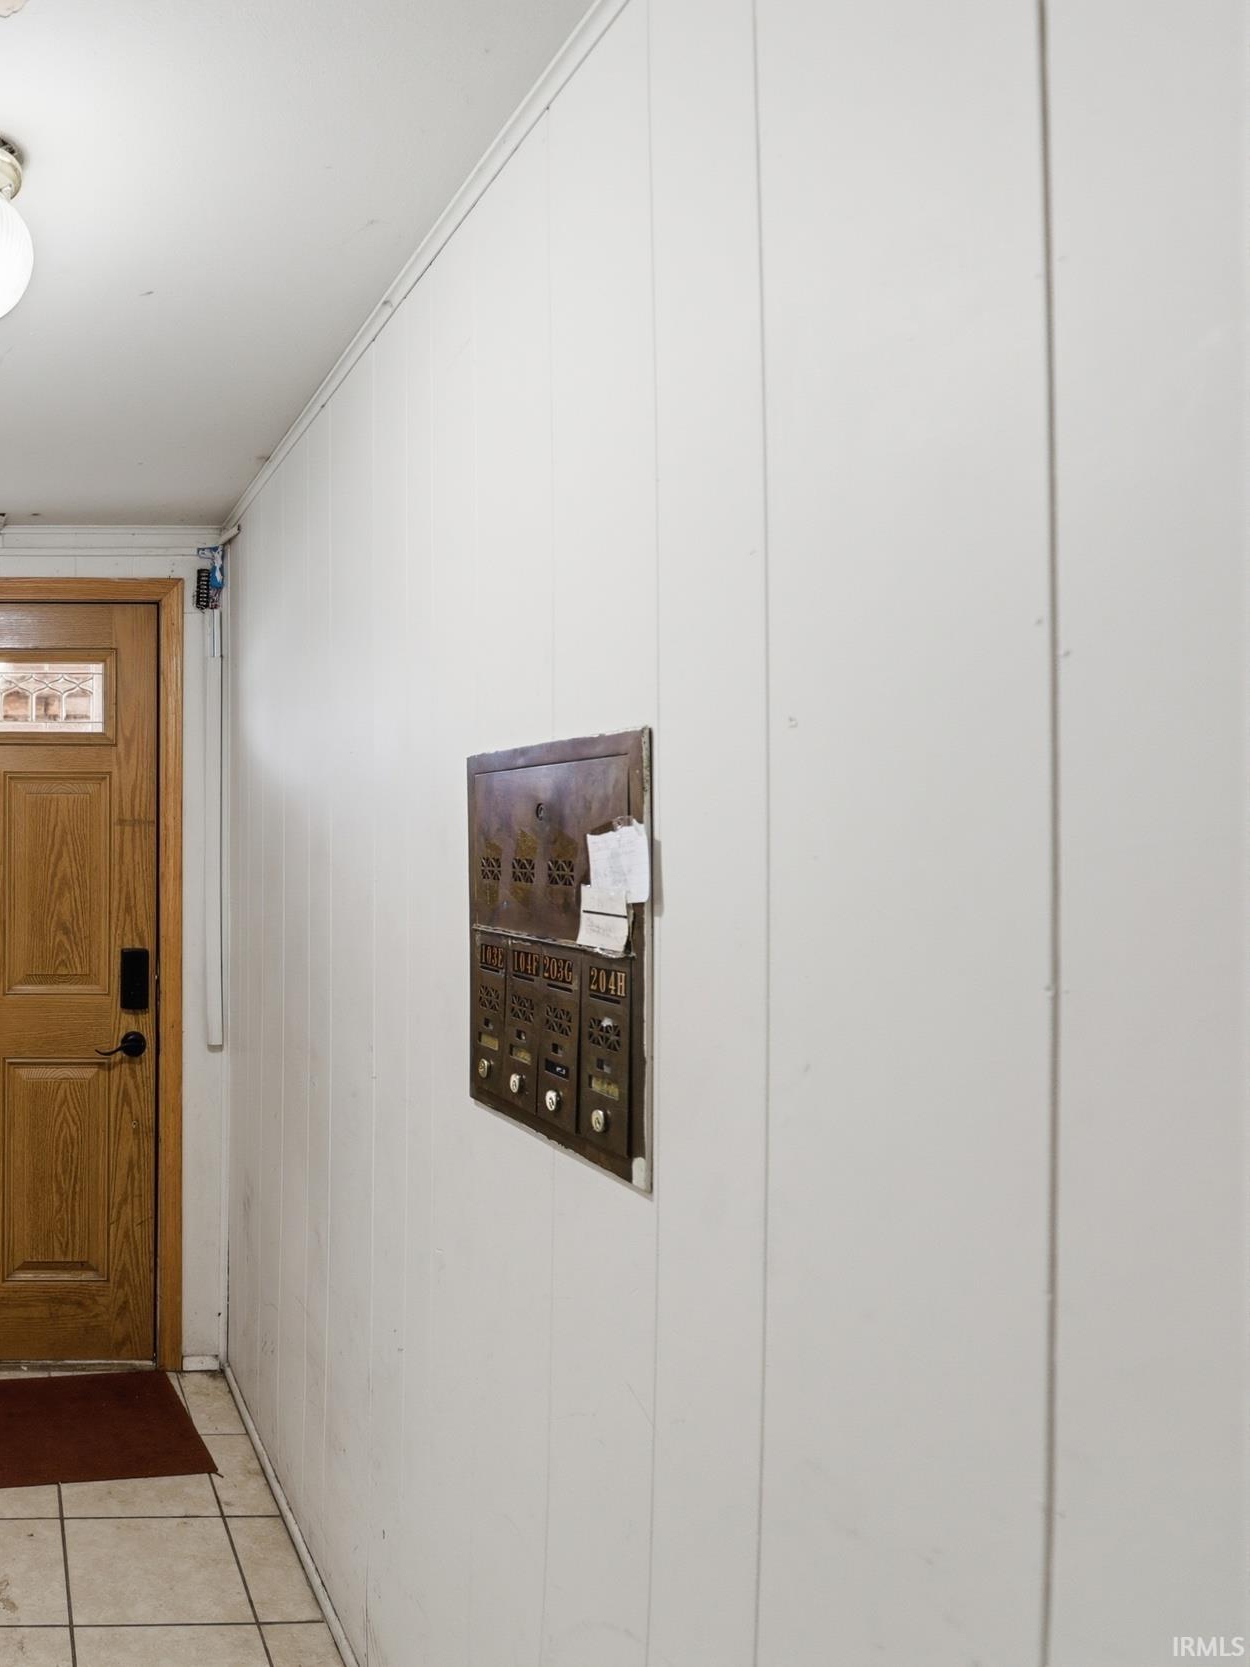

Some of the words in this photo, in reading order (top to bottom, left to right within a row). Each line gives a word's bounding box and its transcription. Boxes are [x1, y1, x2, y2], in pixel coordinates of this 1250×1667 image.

[481, 944, 504, 968] 103E
[514, 951, 540, 976] 104F
[543, 956, 573, 982] 203G
[590, 967, 626, 997] 204H
